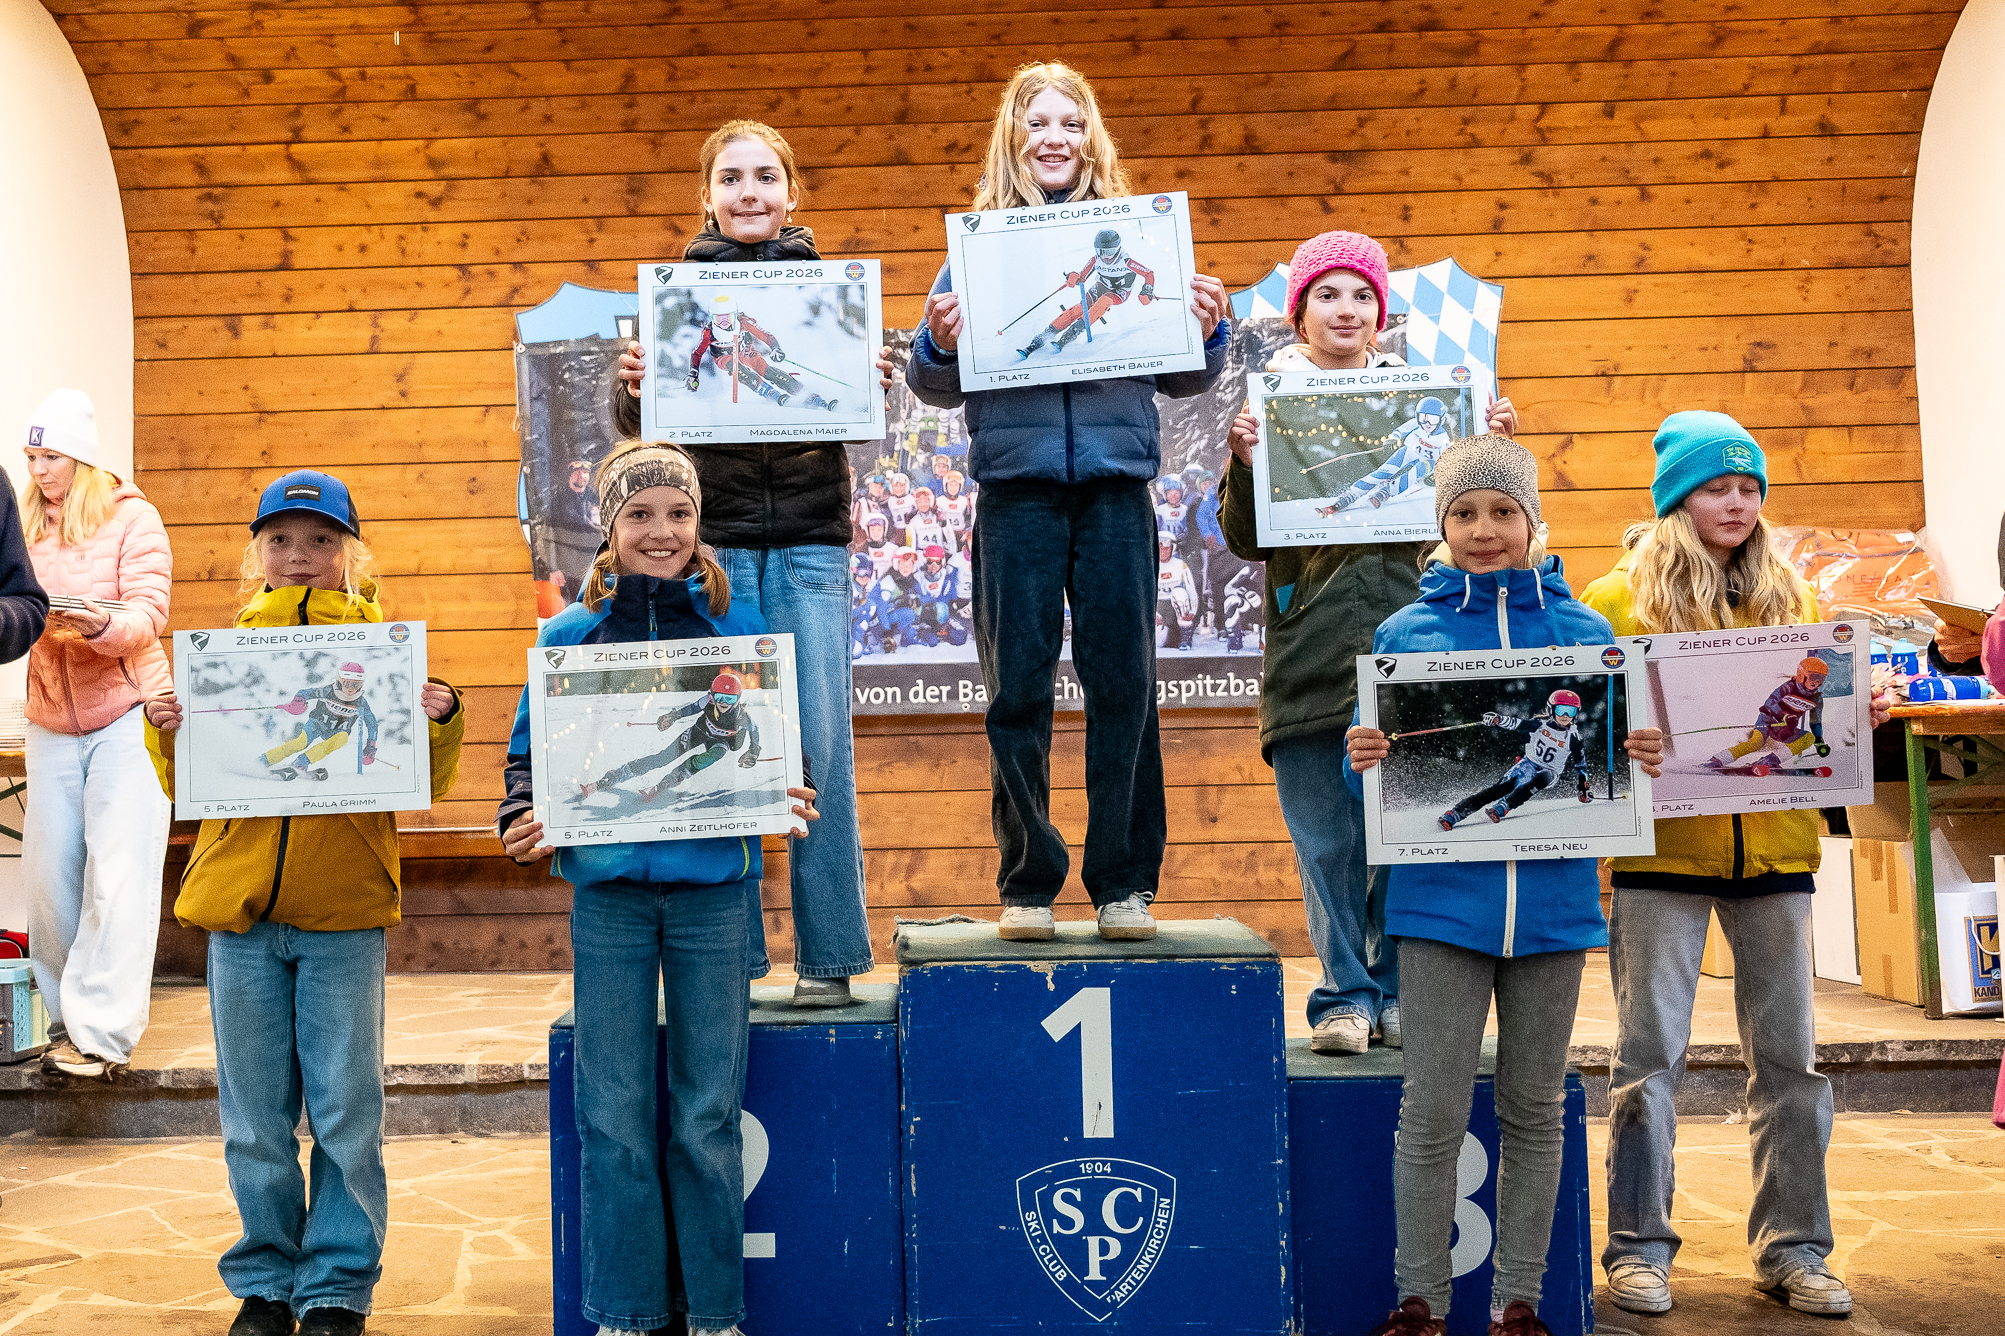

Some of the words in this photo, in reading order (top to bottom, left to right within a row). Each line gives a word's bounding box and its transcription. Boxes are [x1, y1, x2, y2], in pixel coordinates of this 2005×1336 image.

[1006, 213, 1056, 225] ZIENER
[1060, 210, 1090, 220] CUP
[1093, 205, 1131, 216] 2026
[699, 270, 749, 279] ZIENER
[753, 270, 783, 278] CUP
[786, 269, 823, 278] 2026
[1071, 365, 1126, 375] ELISABETH
[1128, 361, 1163, 370] BAUER
[998, 374, 1030, 382] PLATZ
[1306, 377, 1356, 387] ZIENER
[1359, 375, 1389, 385] CUP
[1392, 373, 1430, 382] 2026
[286, 488, 319, 496] SALOMON
[236, 635, 288, 646] ZIENER
[292, 633, 324, 643] CUP
[327, 631, 366, 642] 2026
[1678, 639, 1731, 650] ZIENER
[1735, 636, 1767, 646] CUP
[1770, 632, 1810, 644] 2026
[594, 651, 649, 662] ZIENER
[653, 648, 686, 659] CUP
[690, 645, 731, 657] 2026
[1427, 661, 1486, 672] ZIENER
[1491, 658, 1526, 669] CUP
[1530, 655, 1575, 667] 2026
[855, 686, 902, 705] von
[908, 679, 951, 704] der
[1156, 672, 1264, 704] gspitzba
[1535, 739, 1557, 763] 56
[204, 805, 214, 813] 5.
[216, 804, 250, 812] PLATZ
[302, 800, 337, 808] PAULA
[340, 799, 376, 807] GRIMM
[1661, 804, 1694, 812] PLATZ
[1749, 798, 1787, 806] AMELIE
[1790, 796, 1817, 804] BELL
[564, 831, 575, 839] 5.
[578, 830, 613, 839] PLATZ
[659, 825, 687, 834] ANNI
[689, 822, 758, 832] ZEITLHOFER
[1411, 847, 1449, 856] PLATZ
[1512, 844, 1559, 852] TERESA
[1562, 842, 1588, 851] NEU
[1040, 987, 1115, 1139] 1
[1079, 1162, 1112, 1174] 1904
[1106, 1197, 1171, 1303] PARTENKIRCHEN
